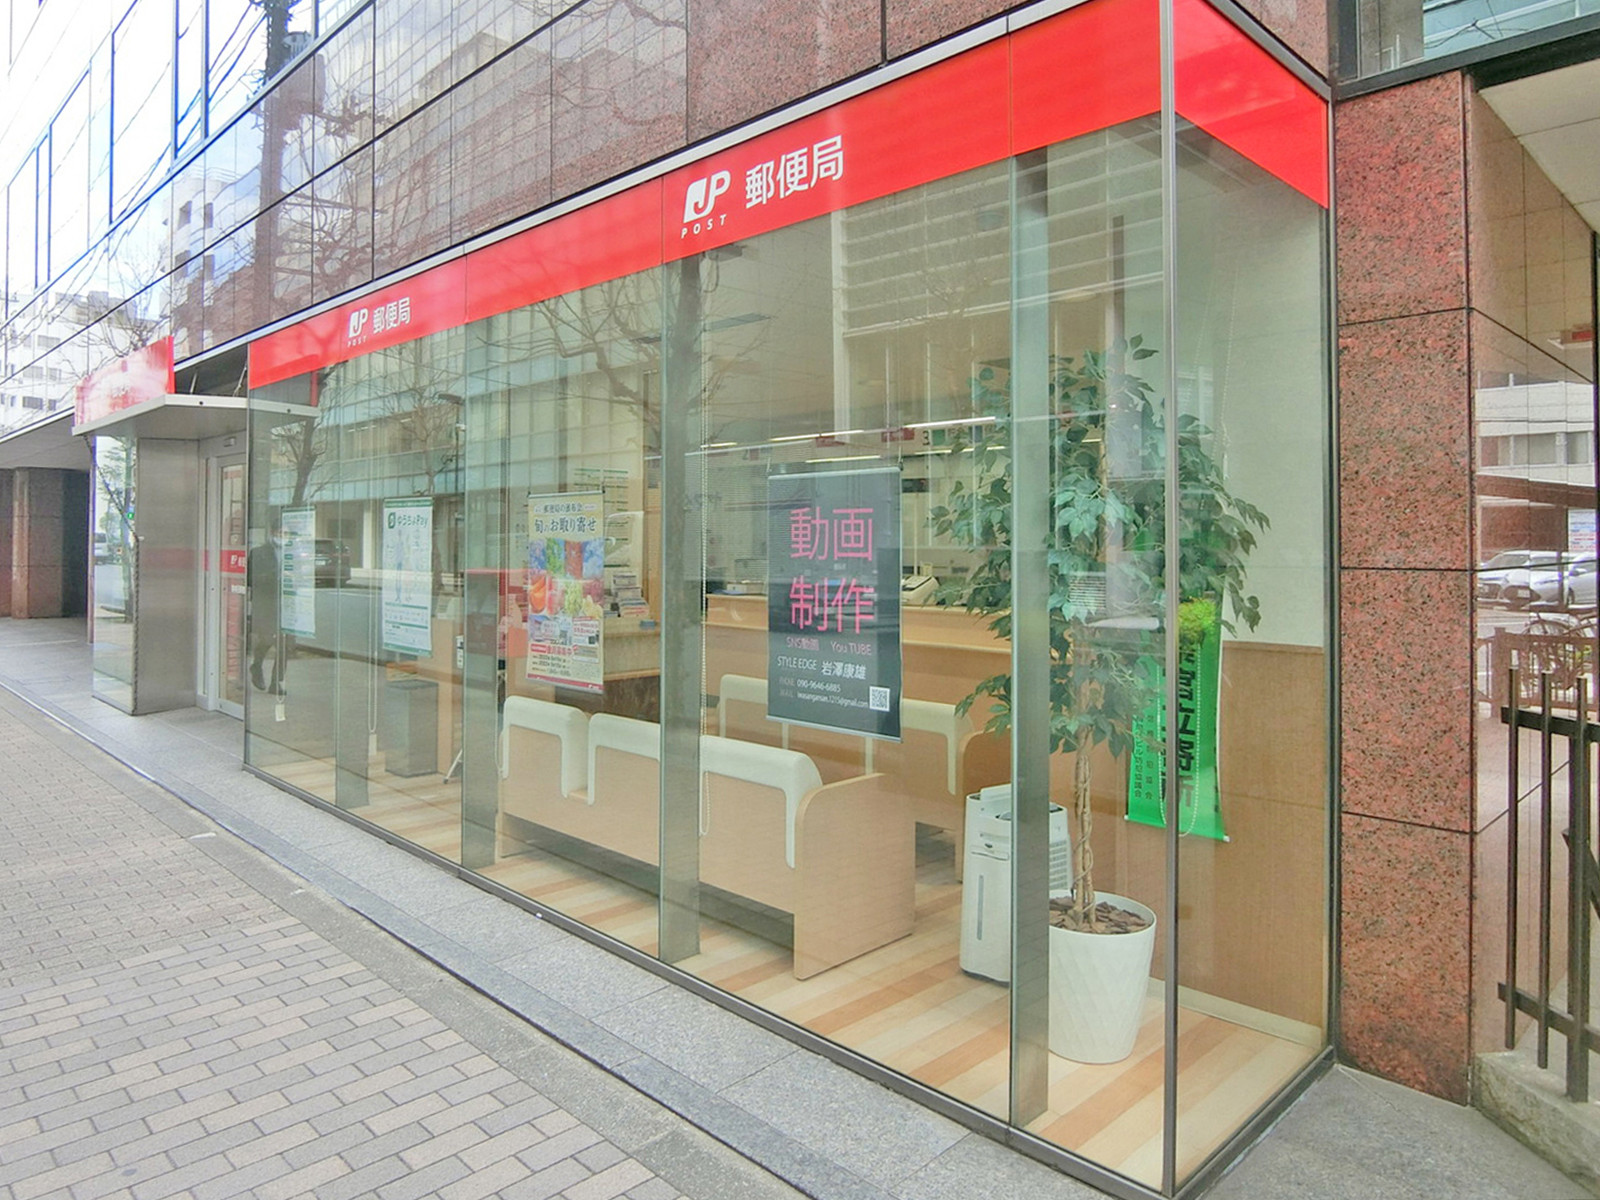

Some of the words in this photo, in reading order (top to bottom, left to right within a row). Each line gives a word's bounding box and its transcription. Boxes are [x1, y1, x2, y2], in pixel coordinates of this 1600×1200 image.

[745, 135, 844, 209] 郵便局
[680, 213, 727, 239] POST
[373, 297, 410, 334] 郵便局
[347, 335, 367, 348] POST
[922, 430, 930, 446] 3
[789, 506, 874, 561] 動画
[789, 575, 875, 635] 制作
[848, 642, 872, 656] TUBE
[777, 656, 797, 669] STYLE
[798, 658, 817, 670] EDGE
